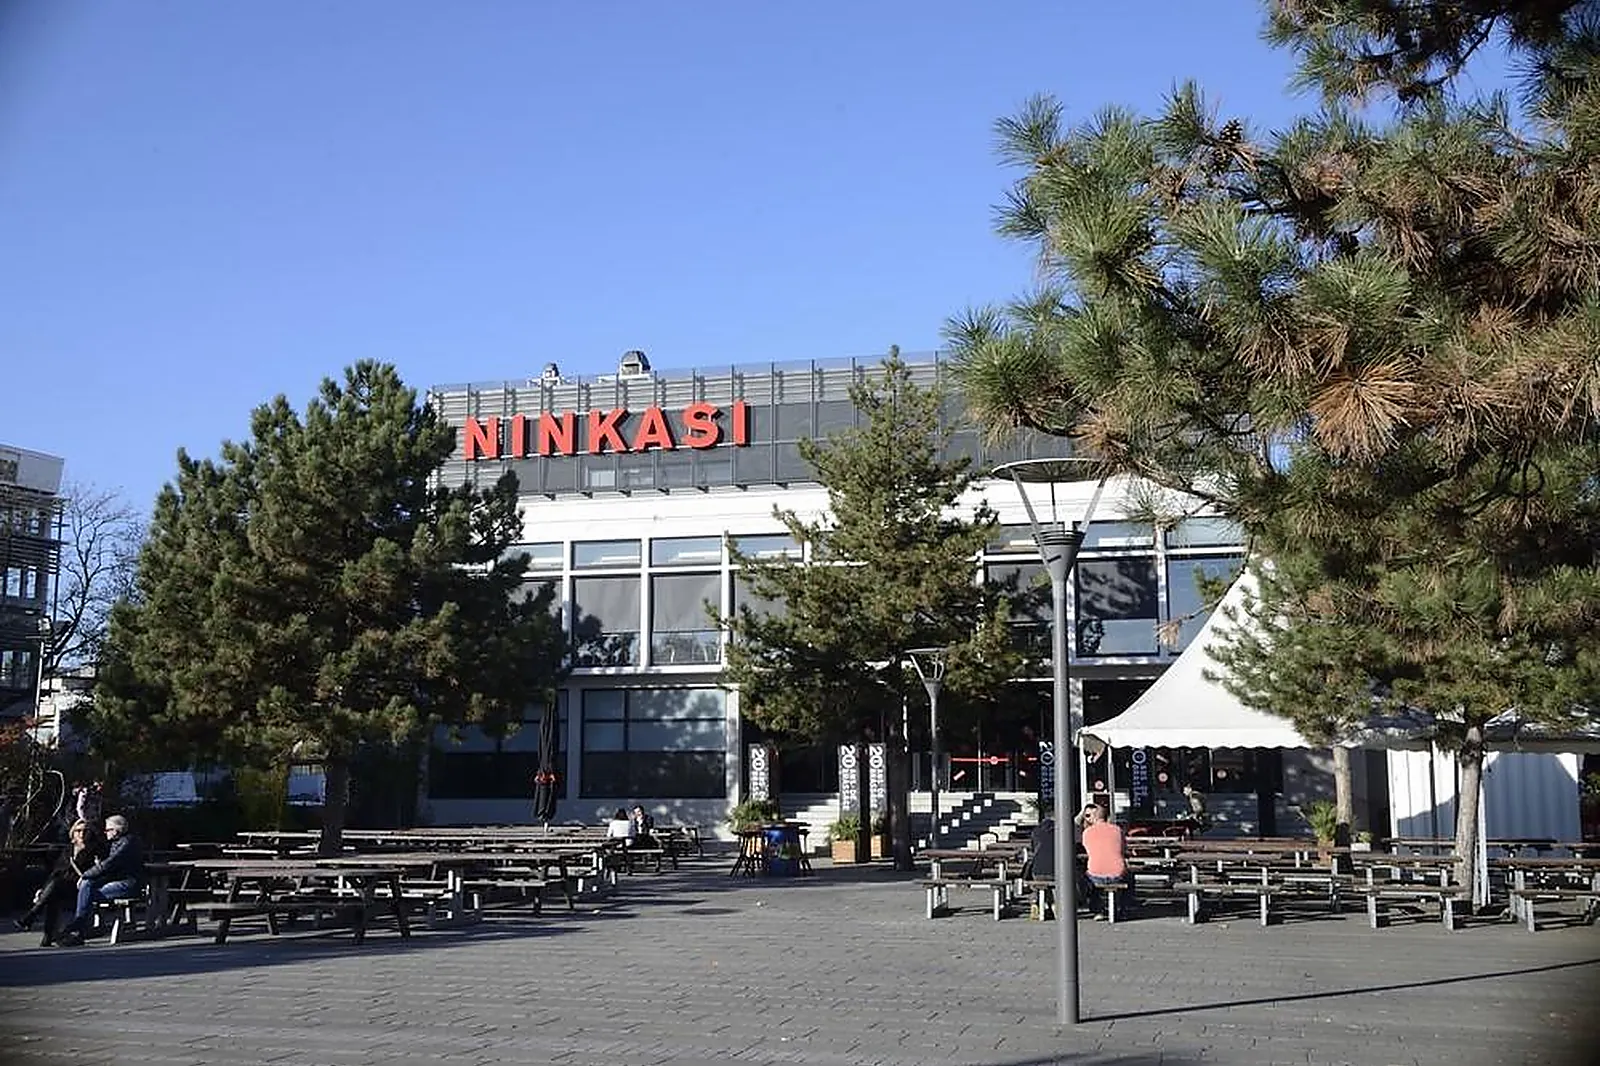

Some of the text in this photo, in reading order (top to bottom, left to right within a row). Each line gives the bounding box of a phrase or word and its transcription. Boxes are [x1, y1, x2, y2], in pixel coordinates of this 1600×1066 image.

[464, 400, 746, 461] NINKASI
[752, 748, 765, 771] 20
[841, 745, 856, 769] 20
[869, 745, 883, 769] 20
